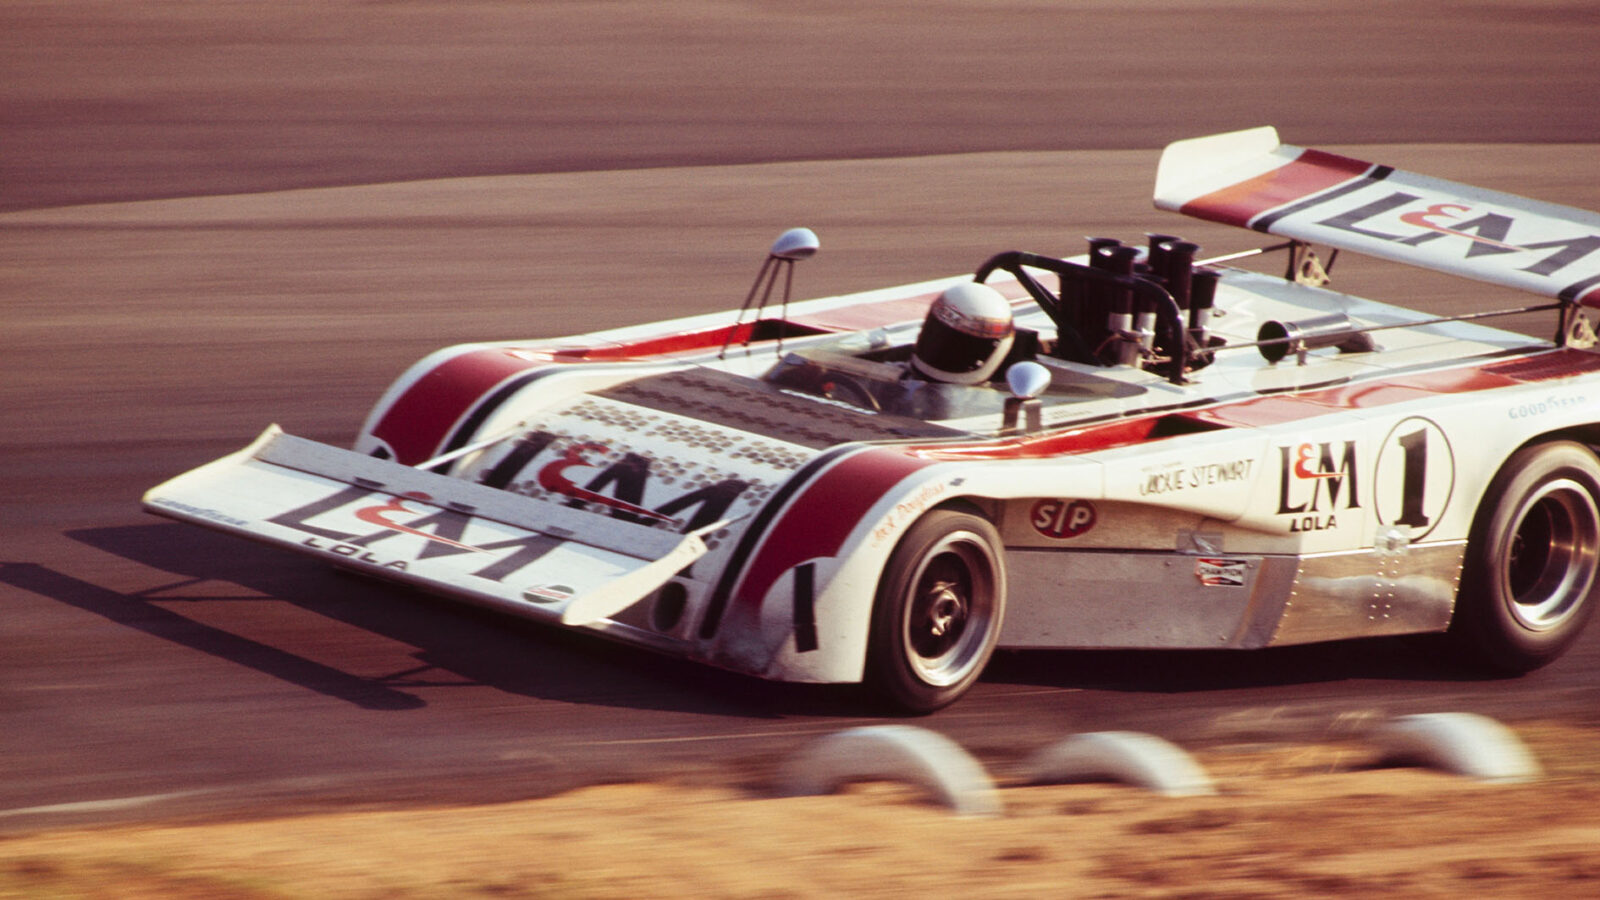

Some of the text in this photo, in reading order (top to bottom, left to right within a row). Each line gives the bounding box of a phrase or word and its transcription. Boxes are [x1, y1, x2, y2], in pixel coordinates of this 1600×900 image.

[1315, 191, 1600, 277] L&M
[1139, 457, 1255, 497] JACKIE STEWART
[1274, 436, 1363, 515] L&M
[1393, 428, 1430, 529] 1
[264, 478, 575, 584] L&M
[1034, 498, 1092, 534] STP
[1288, 514, 1338, 532] LOLA
[302, 537, 408, 572] LOLA
